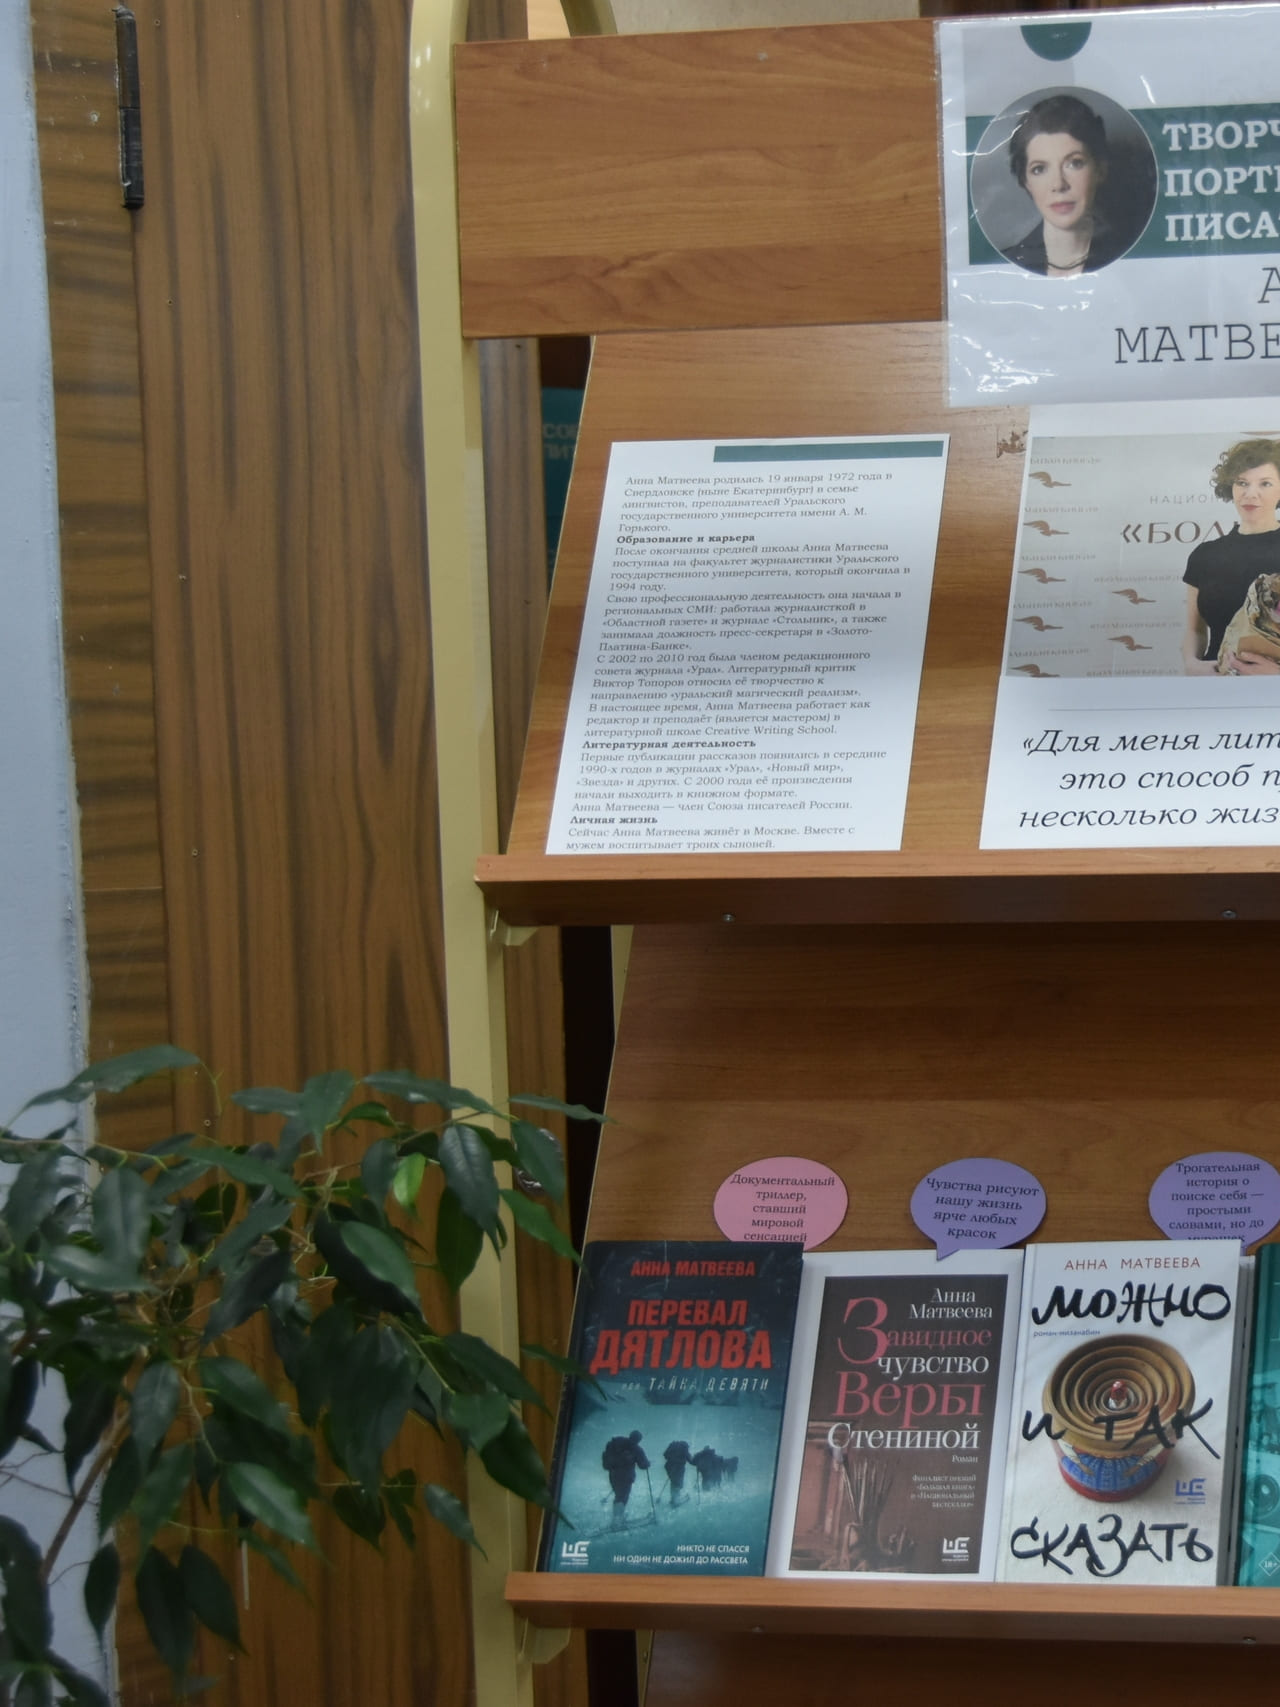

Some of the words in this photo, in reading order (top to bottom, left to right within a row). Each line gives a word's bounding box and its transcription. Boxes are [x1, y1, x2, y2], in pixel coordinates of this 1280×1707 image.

[615, 532, 694, 545] Образование
[707, 535, 755, 544] карьера
[580, 739, 669, 751] Литературная
[670, 740, 757, 748] деятельность
[1022, 728, 1100, 757] «Для
[1108, 733, 1200, 752] меня
[1058, 771, 1126, 790] это
[1137, 763, 1254, 789] способ
[568, 815, 616, 824] Личная
[1019, 807, 1197, 828] несколько
[1173, 1160, 1262, 1176] Трогательная
[727, 1173, 838, 1188] Документальный
[925, 1177, 982, 1196] Чувства
[985, 1180, 1042, 1199] рисуют
[1185, 1175, 1239, 1190] история
[1241, 1175, 1251, 1189] о
[754, 1189, 809, 1204] триллер,
[935, 1196, 973, 1209] нашу
[977, 1195, 1022, 1210] жизнь
[1170, 1190, 1216, 1202] поиске
[1218, 1188, 1248, 1202] себя
[750, 1203, 809, 1216] ставший
[1185, 1206, 1253, 1219] простыми
[749, 1217, 806, 1230] мировой
[933, 1209, 966, 1226] ярче
[970, 1212, 1017, 1225] любых
[1168, 1220, 1226, 1232] словами,
[1229, 1217, 1246, 1231] но
[1248, 1219, 1264, 1230] до
[741, 1232, 809, 1242] сенсацией
[945, 1227, 999, 1240] красок
[631, 1260, 670, 1277] АННА
[674, 1260, 756, 1277] МАТВЕЕВА
[1064, 1259, 1108, 1270] АННА
[1121, 1257, 1200, 1269] МАТВЕЕВА
[931, 1287, 976, 1303] Анна
[627, 1299, 748, 1326] ПЕРЕВАЛ
[909, 1303, 993, 1319] Матвеева
[837, 1297, 992, 1364] Завидное
[589, 1330, 773, 1375] ДЯТЛОВА
[877, 1356, 990, 1381] чувство
[649, 1376, 698, 1392] ТАЙНА
[706, 1377, 770, 1393] ДЕВЯТИ
[832, 1371, 986, 1429] Веры
[827, 1422, 981, 1449] Стениной
[951, 1454, 978, 1463] Роман
[676, 1544, 705, 1553] НИКТО
[705, 1544, 716, 1552] НЕ
[716, 1544, 750, 1553] СПАССЯ
[626, 1554, 651, 1565] ОДИН
[651, 1555, 662, 1563] НЕ
[662, 1555, 695, 1565] ДОЖИЛ
[694, 1555, 709, 1565] ДО
[709, 1555, 748, 1565] РАССВЕТА
